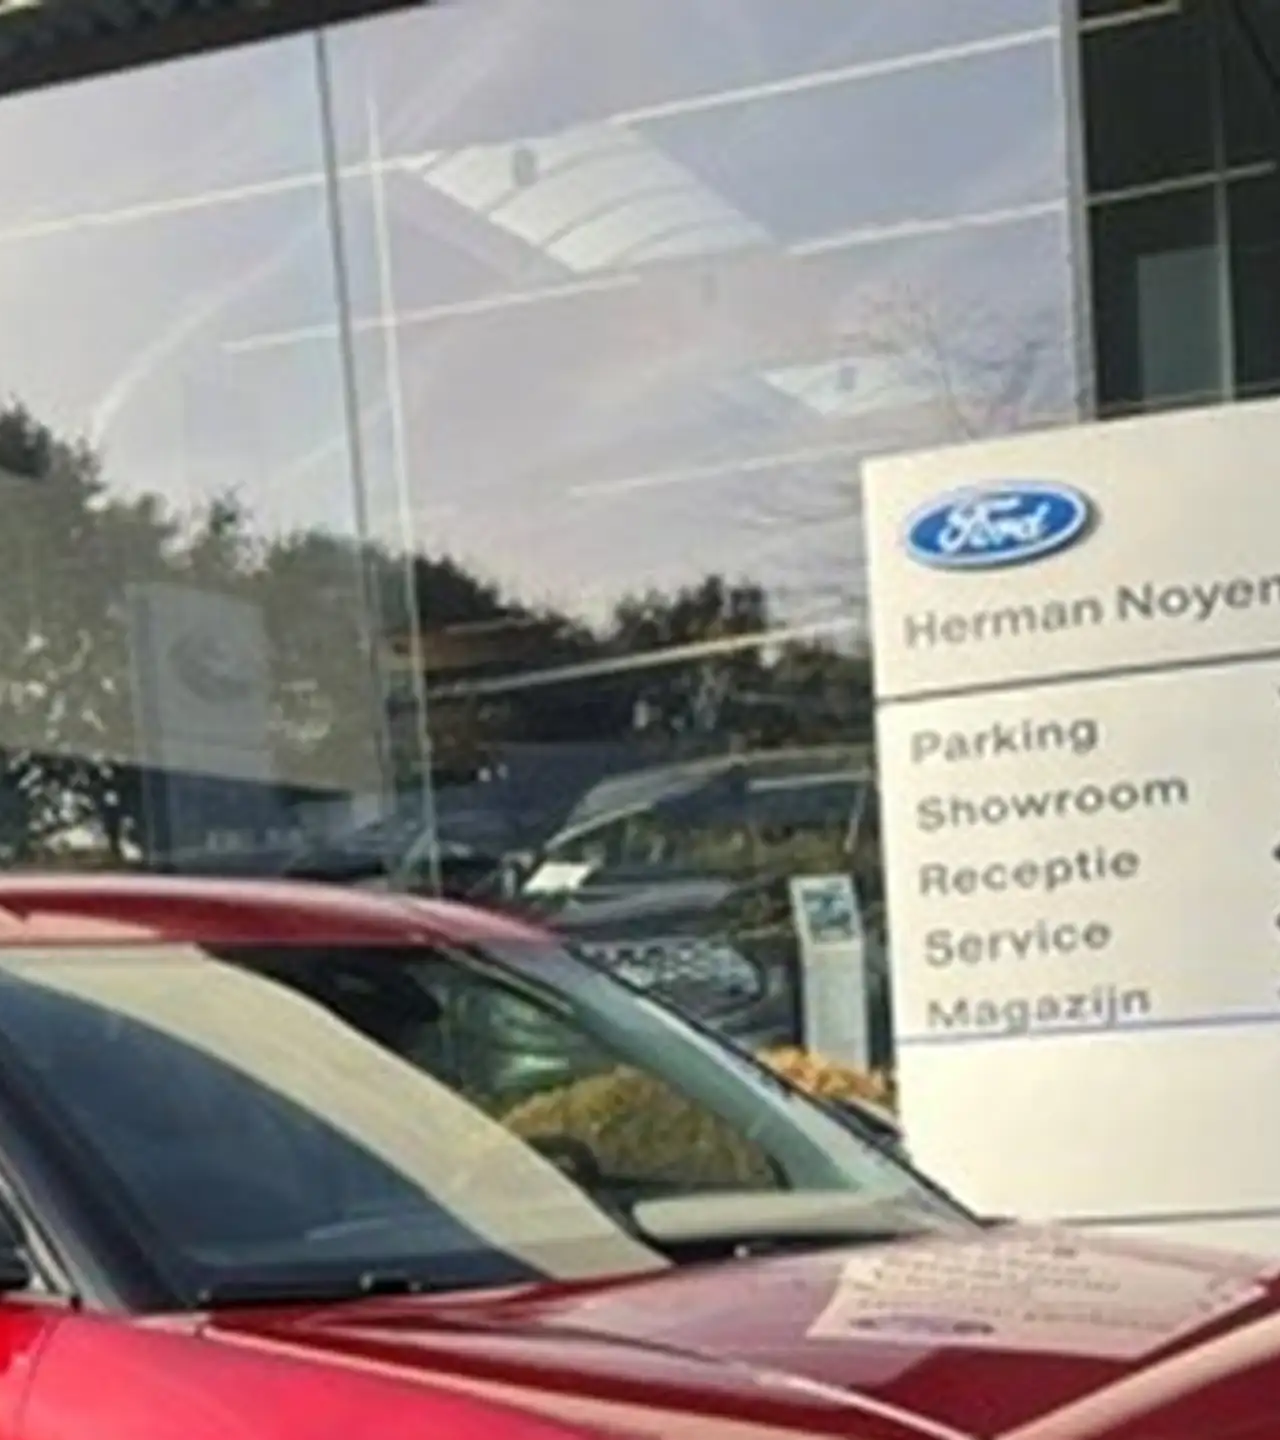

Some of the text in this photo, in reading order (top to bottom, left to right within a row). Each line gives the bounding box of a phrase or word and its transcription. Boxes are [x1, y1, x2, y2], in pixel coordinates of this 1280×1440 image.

[902, 596, 1105, 650] Herman
[910, 717, 1100, 765] Parking
[915, 774, 1189, 833] Showroom
[919, 845, 1141, 897] Receptie
[924, 919, 1113, 969] Service
[926, 984, 1151, 1035] Magazijn
